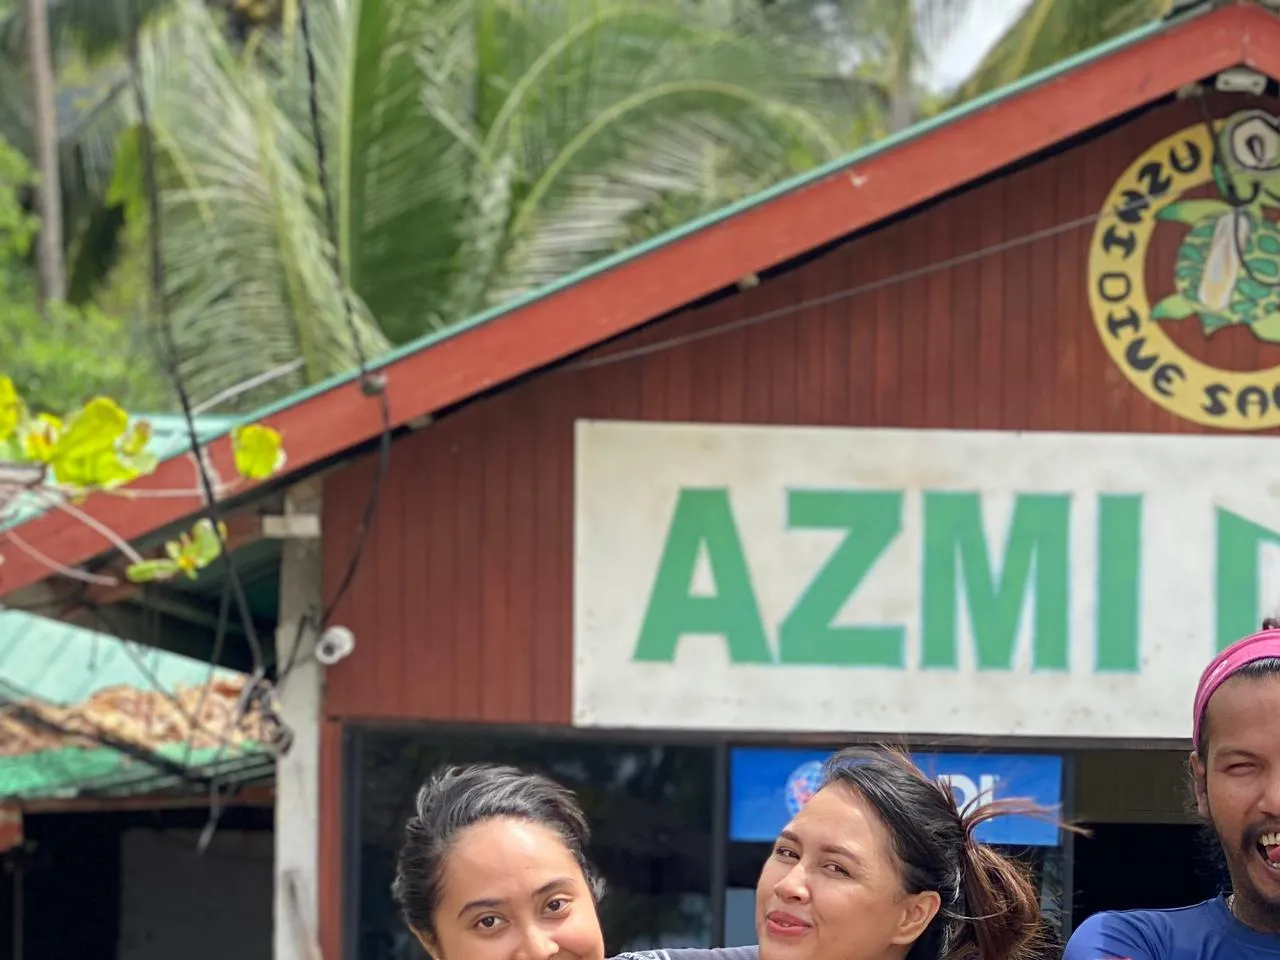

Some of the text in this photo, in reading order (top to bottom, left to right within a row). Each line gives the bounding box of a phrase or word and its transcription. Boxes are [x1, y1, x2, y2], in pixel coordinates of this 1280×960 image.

[1097, 272, 1188, 397] DIVE
[632, 485, 1145, 673] AZMI
[937, 773, 994, 822] DI
